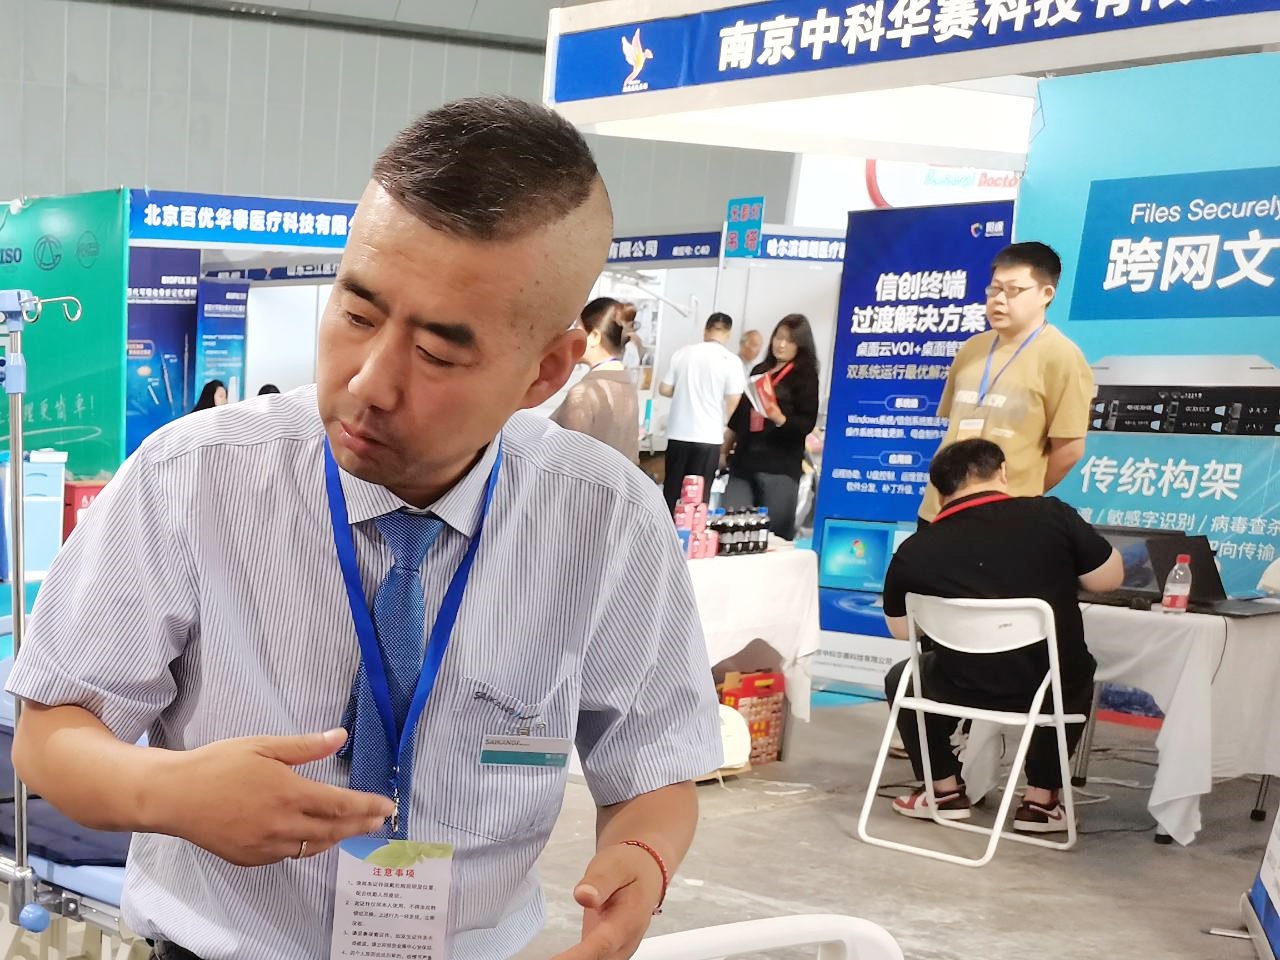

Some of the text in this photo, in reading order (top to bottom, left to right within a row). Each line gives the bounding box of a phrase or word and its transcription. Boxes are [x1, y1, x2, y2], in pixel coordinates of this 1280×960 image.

[718, 0, 1193, 71] 南京中科华赛科技
[1131, 203, 1180, 224] Files
[0, 247, 22, 264] ISO
[1102, 229, 1280, 293] 跨网文
[876, 270, 967, 301] 信创终端
[851, 303, 987, 334] 过渡解决方案
[1080, 456, 1243, 501] 传统构架
[373, 867, 416, 878] 注意事项
